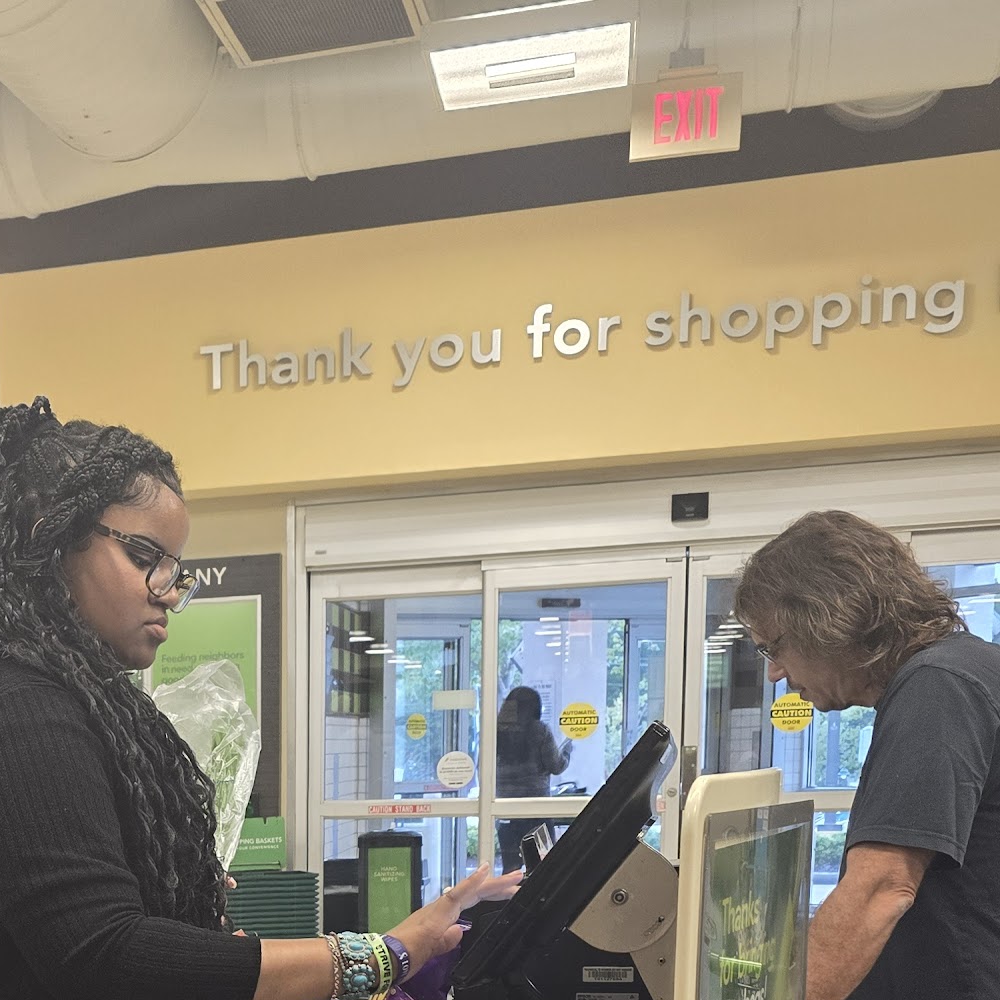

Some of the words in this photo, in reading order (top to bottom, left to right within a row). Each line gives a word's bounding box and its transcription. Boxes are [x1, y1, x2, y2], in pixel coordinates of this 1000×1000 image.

[653, 86, 723, 145] EXIT
[201, 328, 372, 390] Thank
[393, 324, 502, 387] you
[527, 303, 621, 360] for
[644, 274, 967, 350] shopping
[161, 654, 197, 664] Feeding
[198, 652, 245, 662] neighbors
[162, 665, 170, 674] in
[771, 710, 812, 718] CAUTION
[560, 716, 598, 725] CAUTION
[368, 806, 392, 814] CAUTION
[394, 806, 414, 814] STAND
[257, 836, 282, 845] BASKETS
[722, 892, 760, 936] Thanks
[376, 944, 391, 978] STRIVE
